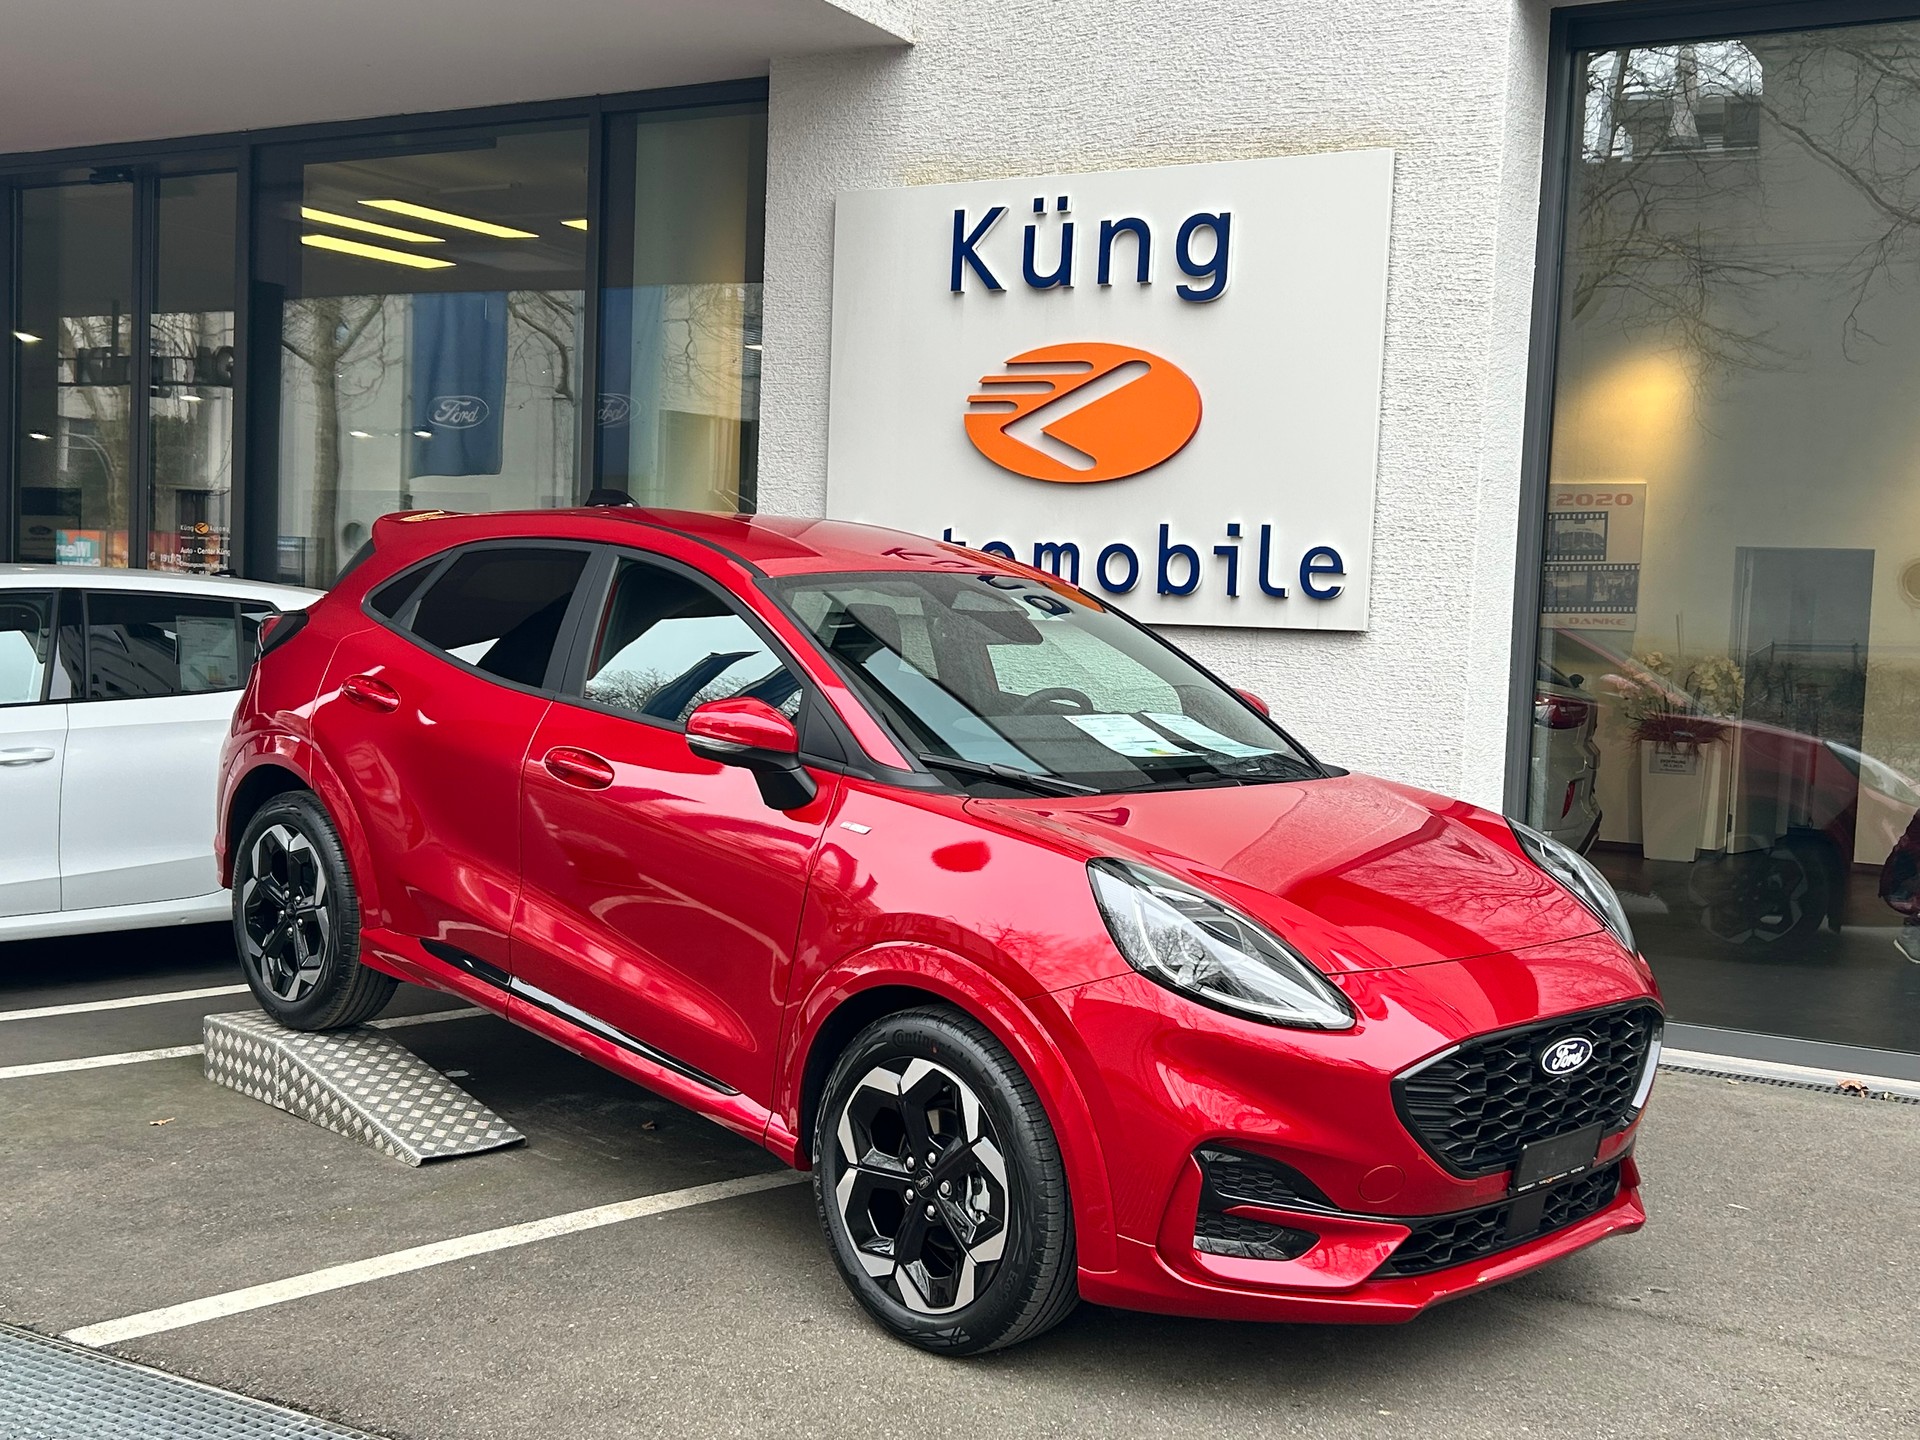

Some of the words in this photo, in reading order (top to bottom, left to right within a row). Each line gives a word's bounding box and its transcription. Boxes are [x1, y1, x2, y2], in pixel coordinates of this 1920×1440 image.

[950, 195, 1234, 303] Küng
[431, 399, 482, 424] Ford
[1555, 493, 1634, 507] 2020
[942, 523, 1347, 601] mobile
[1568, 616, 1628, 627] DANKE
[1550, 1042, 1586, 1071] Ford
